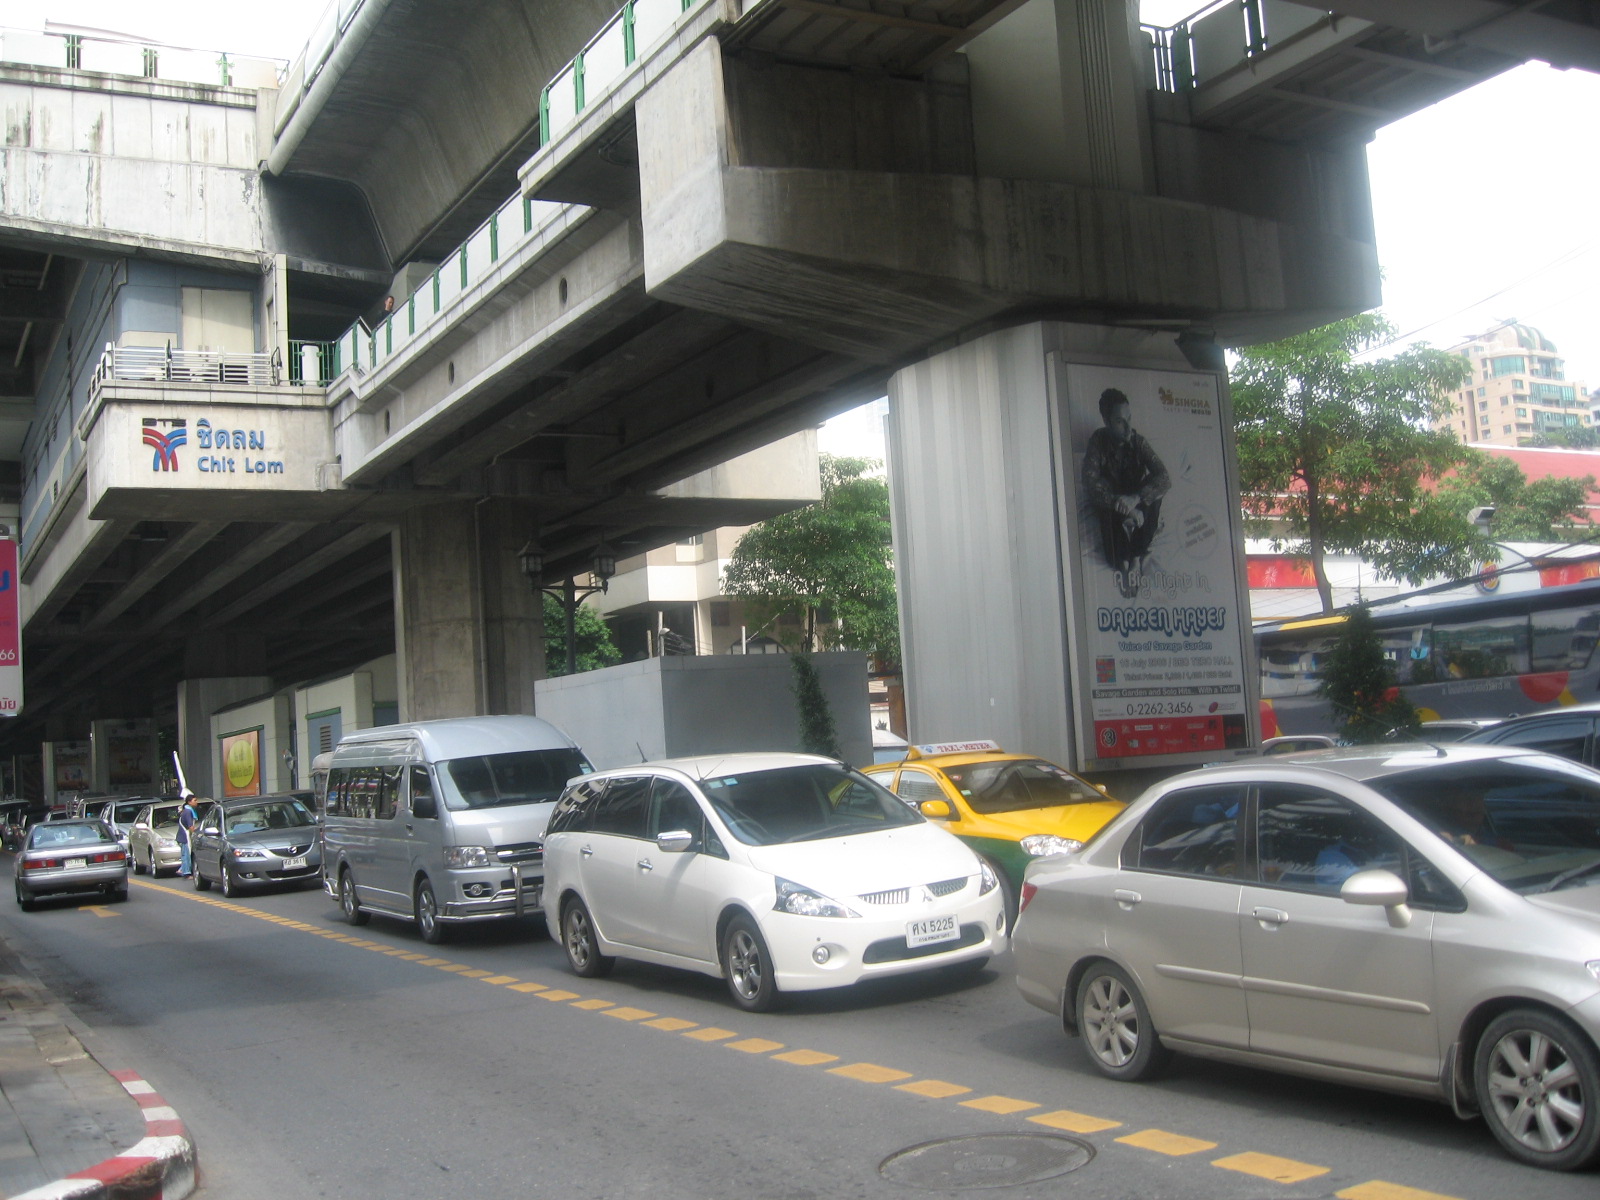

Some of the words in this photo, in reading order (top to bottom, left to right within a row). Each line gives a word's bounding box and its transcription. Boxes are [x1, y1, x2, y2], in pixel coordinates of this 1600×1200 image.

[1174, 398, 1210, 409] SINGHA
[142, 418, 187, 427] BTS
[196, 418, 265, 450] ชิดลม
[197, 456, 236, 473] Chit
[245, 457, 284, 473] Lom
[1128, 570, 1151, 599] Big
[1153, 570, 1191, 599] Night
[1097, 607, 1173, 638] DARREN
[1172, 607, 1226, 637] HAYES
[1118, 641, 1142, 652] Voice
[1143, 641, 1152, 652] of
[1153, 641, 1182, 653] Savage
[1183, 641, 1213, 651] Garden
[1096, 689, 1121, 698] Savage
[1121, 688, 1147, 697] Garden
[1148, 688, 1161, 696] and
[1198, 686, 1213, 694] With
[1220, 685, 1238, 693] Twist!
[1126, 702, 1194, 716] 0-2262-3456
[937, 743, 992, 753] TAXI-METER
[930, 917, 954, 932] 5225
